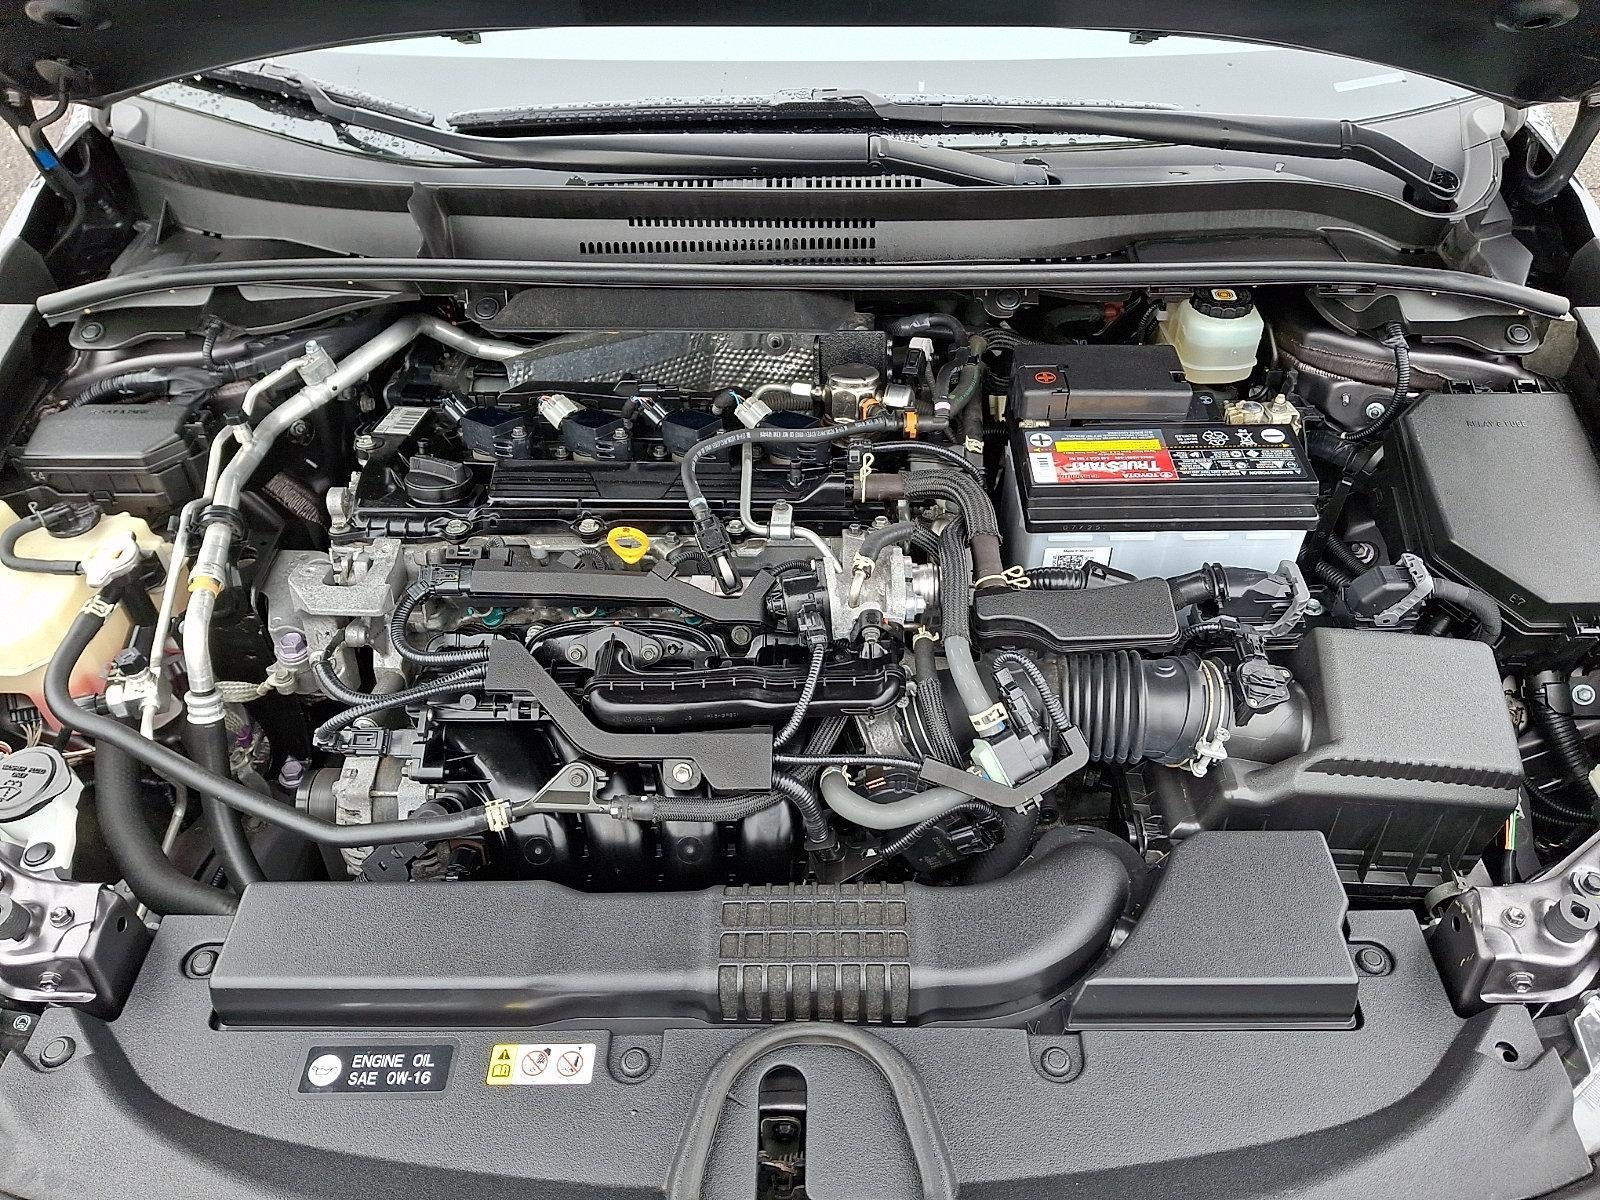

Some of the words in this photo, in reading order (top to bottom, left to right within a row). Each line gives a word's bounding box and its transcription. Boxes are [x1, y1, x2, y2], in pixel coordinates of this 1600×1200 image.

[1123, 470, 1162, 478] TOYOTA
[1509, 593, 1526, 606] E7
[352, 1054, 405, 1068] ENGINE
[412, 1054, 435, 1067] OIL
[348, 1071, 378, 1085] SAE
[386, 1071, 431, 1085] 0W-16
